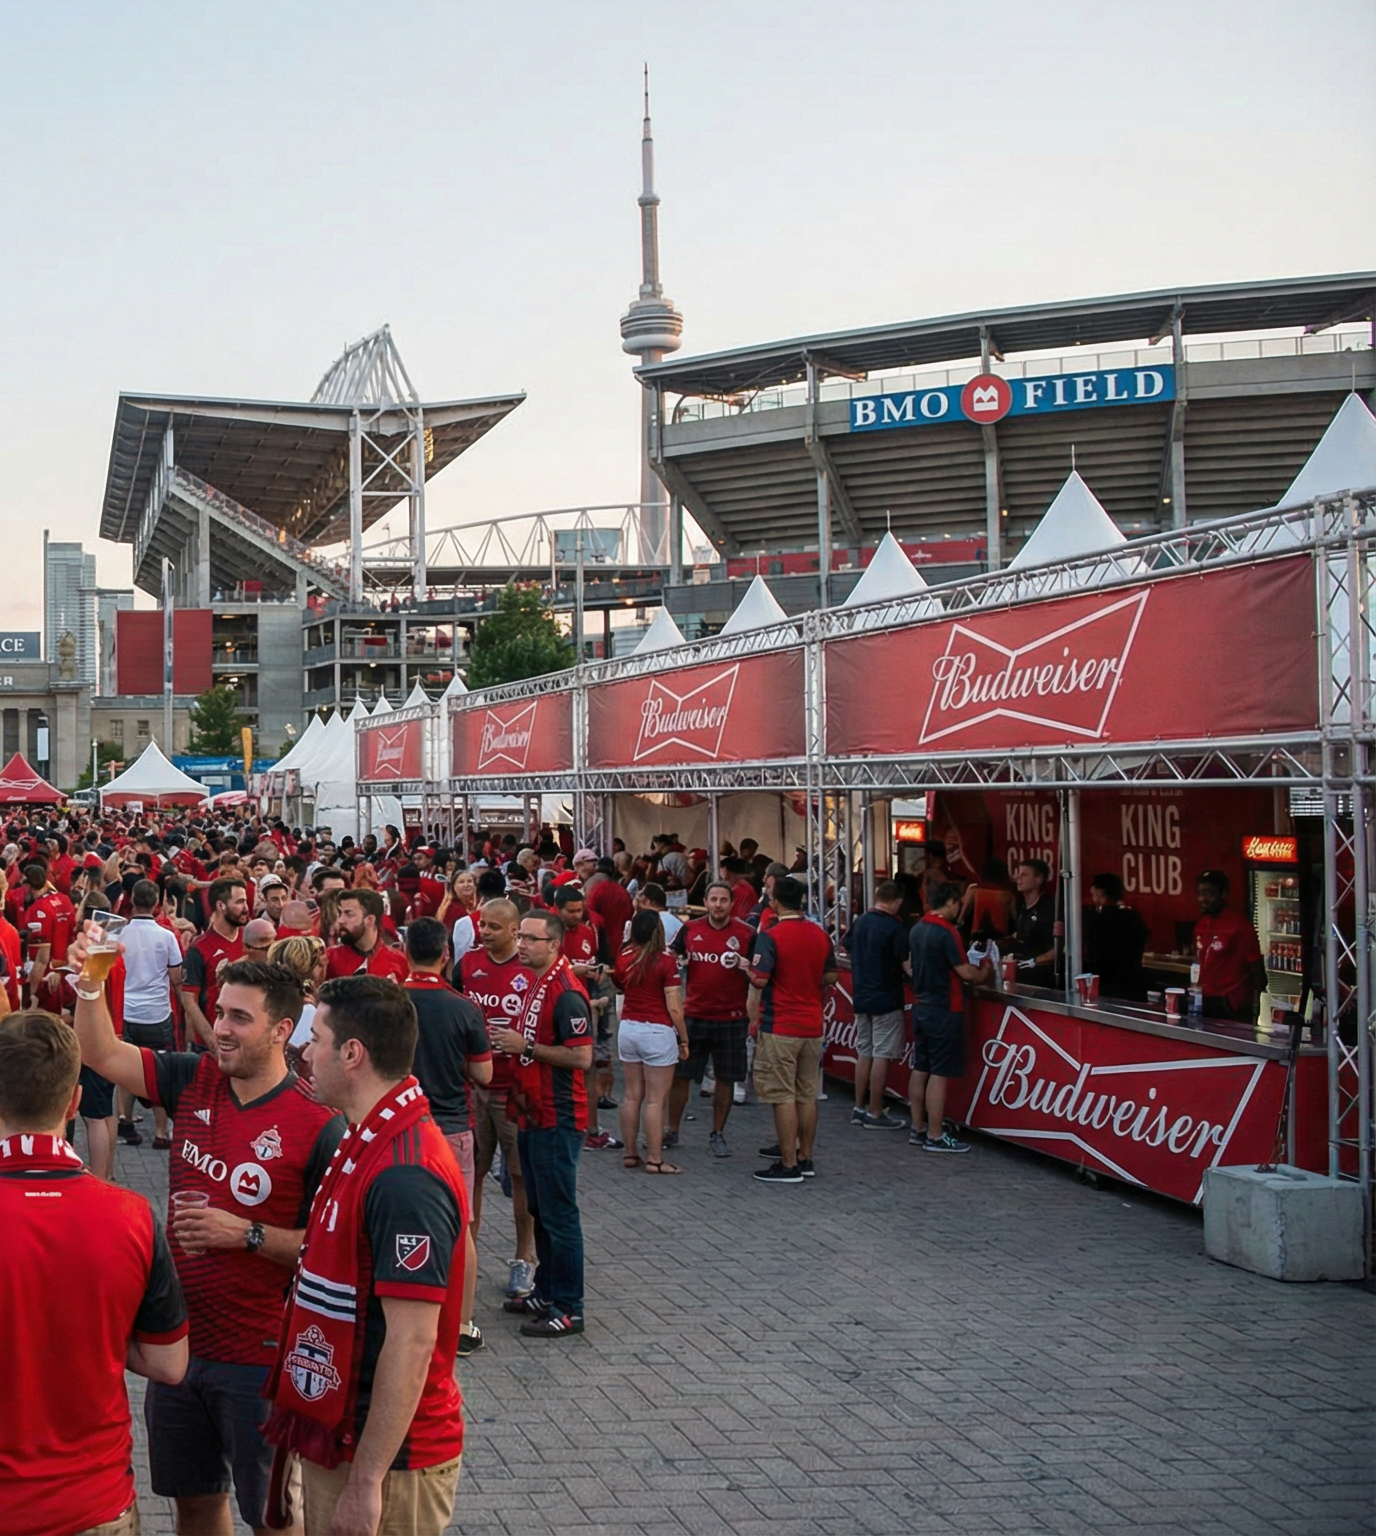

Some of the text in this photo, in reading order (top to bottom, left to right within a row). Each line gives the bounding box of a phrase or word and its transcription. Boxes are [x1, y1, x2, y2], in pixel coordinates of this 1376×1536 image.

[853, 370, 1164, 427] BMO FIELD
[932, 647, 1119, 711] Budweiser
[641, 697, 727, 738] Budweiser
[1006, 803, 1054, 843] KING
[1121, 804, 1181, 848] KING
[1123, 852, 1183, 895] CLUB
[982, 1039, 1224, 1158] Budweiser
